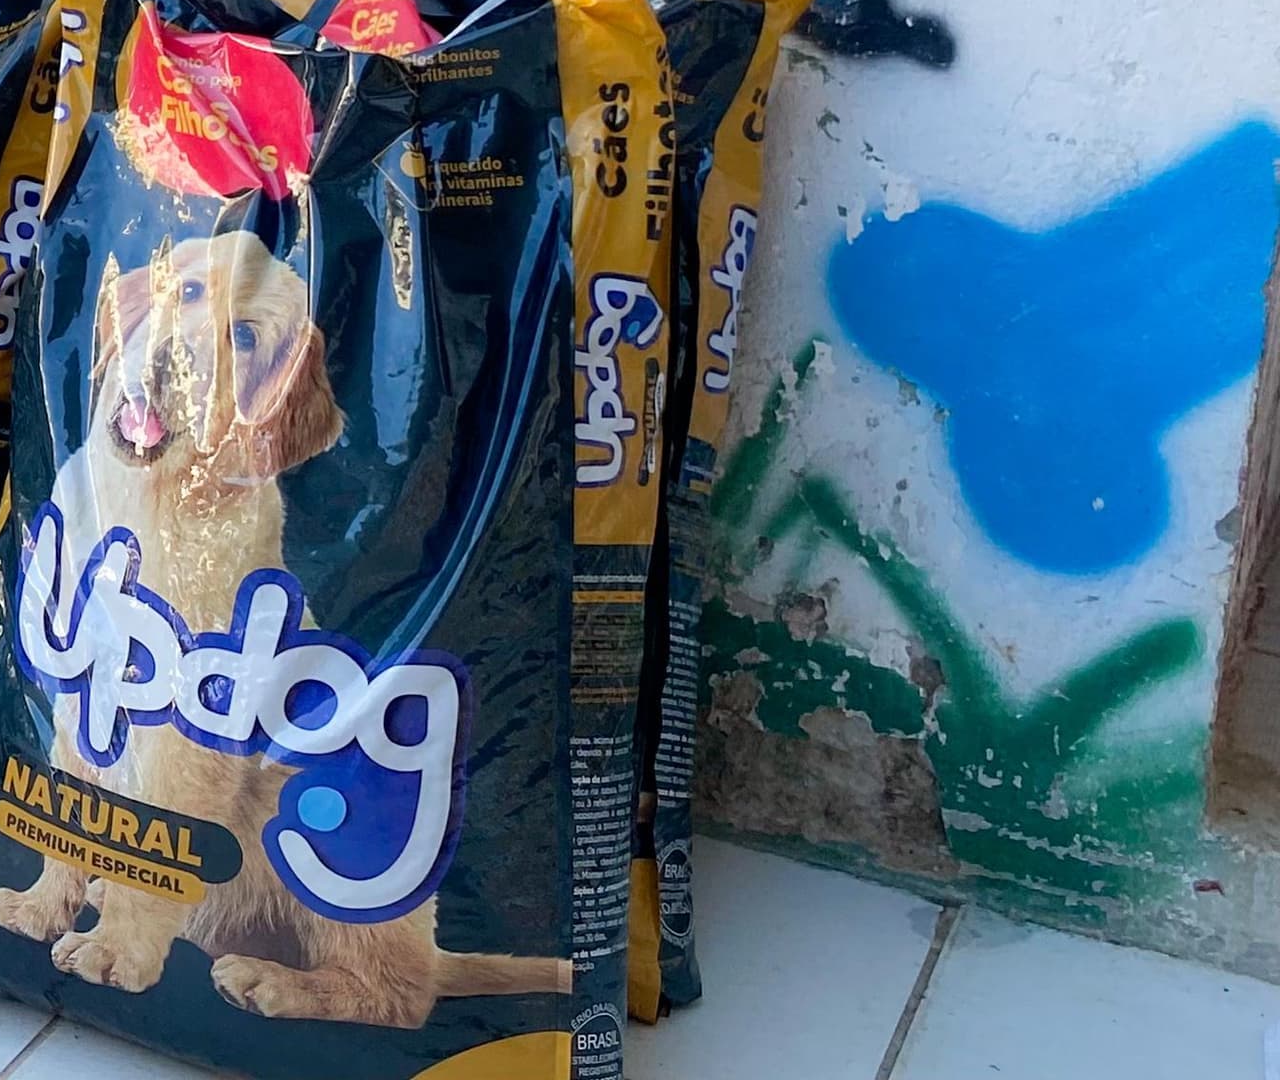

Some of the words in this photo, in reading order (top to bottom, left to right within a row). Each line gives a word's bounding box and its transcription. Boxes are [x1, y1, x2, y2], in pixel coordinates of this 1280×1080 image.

[351, 9, 399, 41] Cães
[439, 48, 501, 62] bonitos
[596, 82, 631, 199] Cães
[436, 192, 494, 208] inerais
[446, 172, 524, 190] vitaminas
[575, 275, 664, 484] Updog
[20, 512, 462, 912] Updog
[2, 755, 202, 867] NATURAL
[6, 812, 85, 862] PREMIUM
[92, 850, 184, 894] ESPECIAL
[577, 1030, 620, 1050] BRASIL
